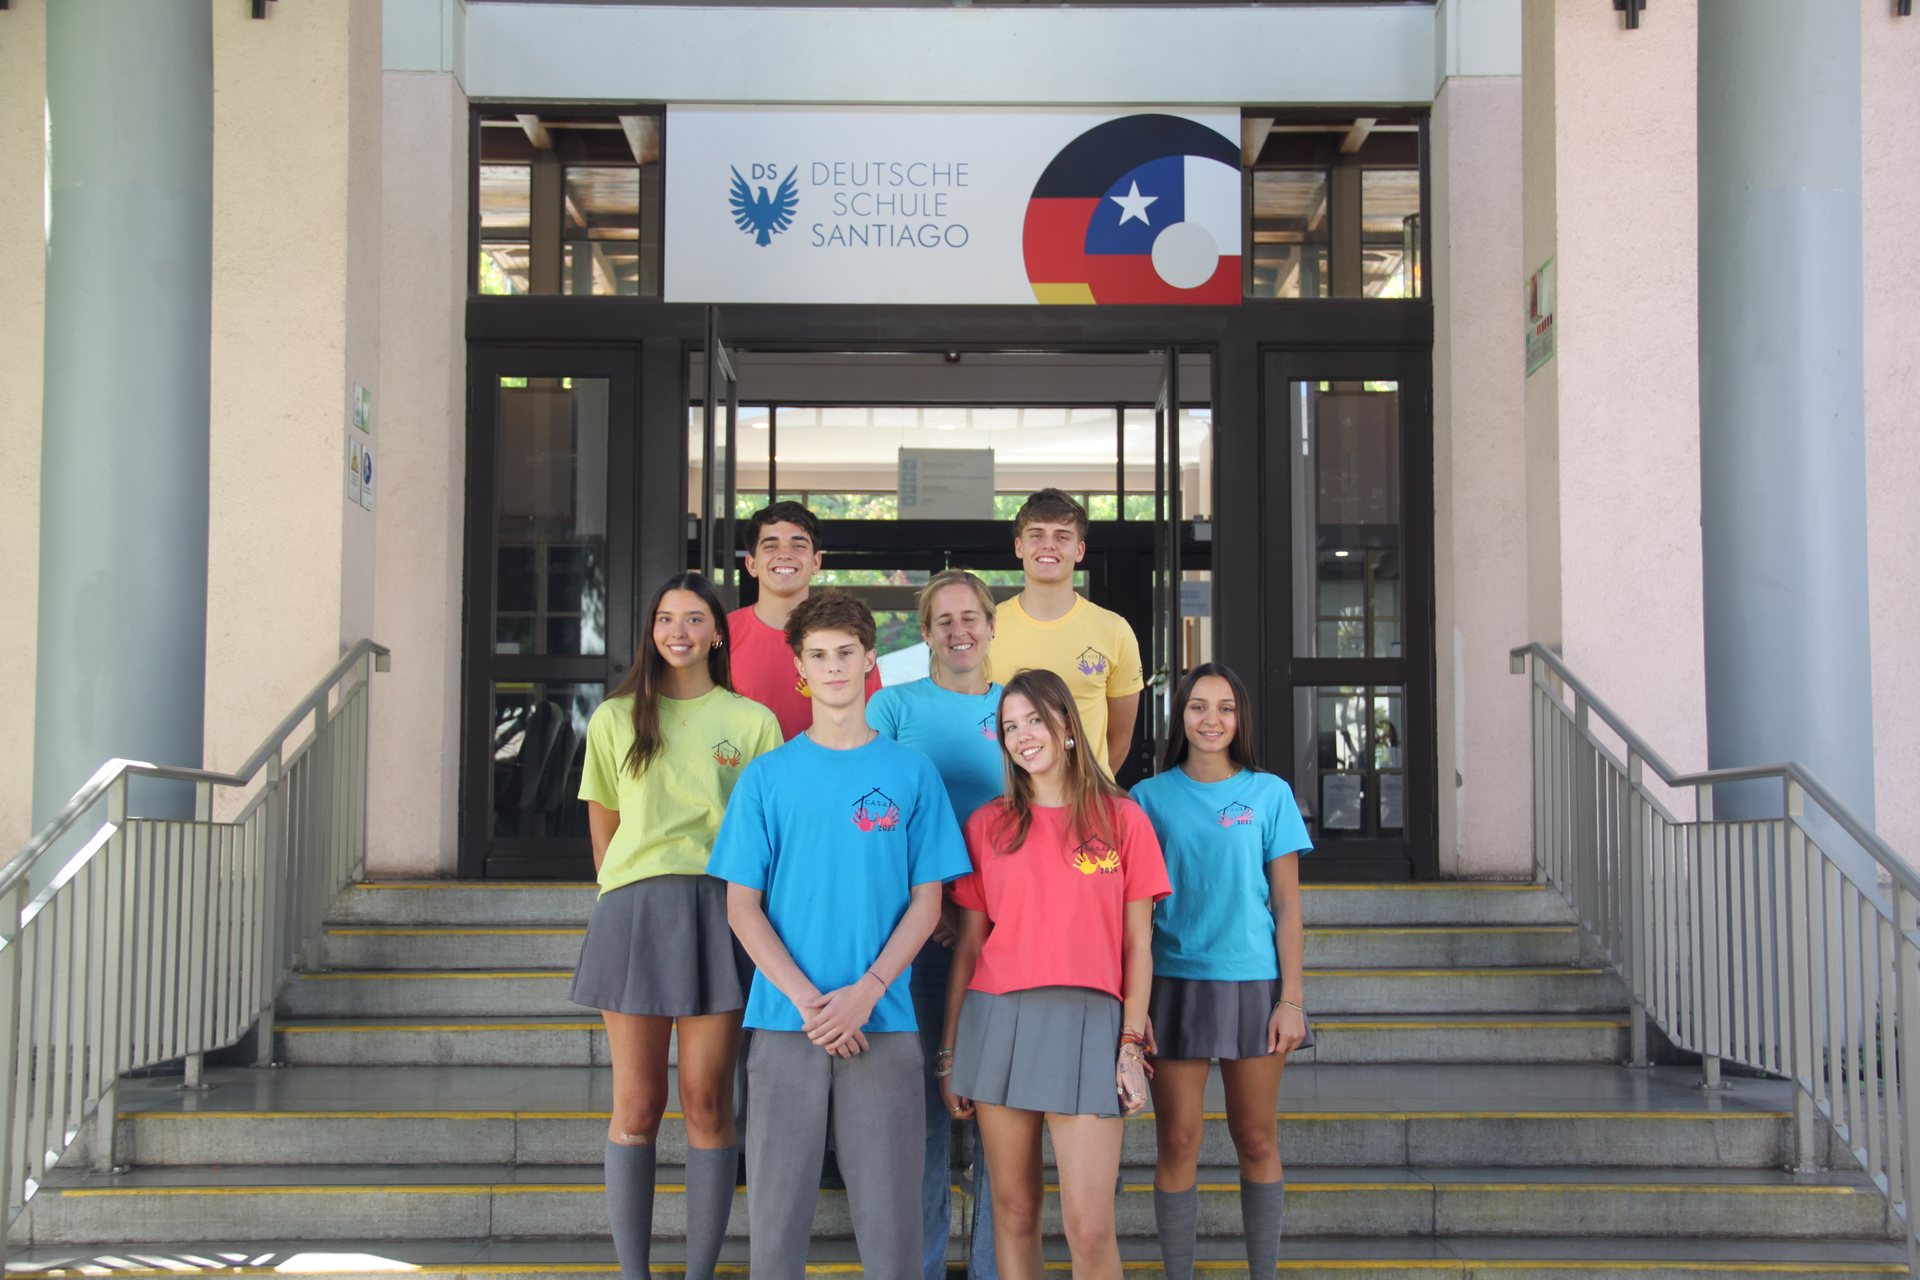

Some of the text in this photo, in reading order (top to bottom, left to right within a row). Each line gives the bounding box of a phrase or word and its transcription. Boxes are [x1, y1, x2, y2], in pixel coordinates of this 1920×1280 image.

[751, 163, 778, 181] DS
[811, 161, 969, 187] DEUTSCHE
[832, 191, 947, 217] SCHULE
[811, 223, 969, 249] SANTIAGO
